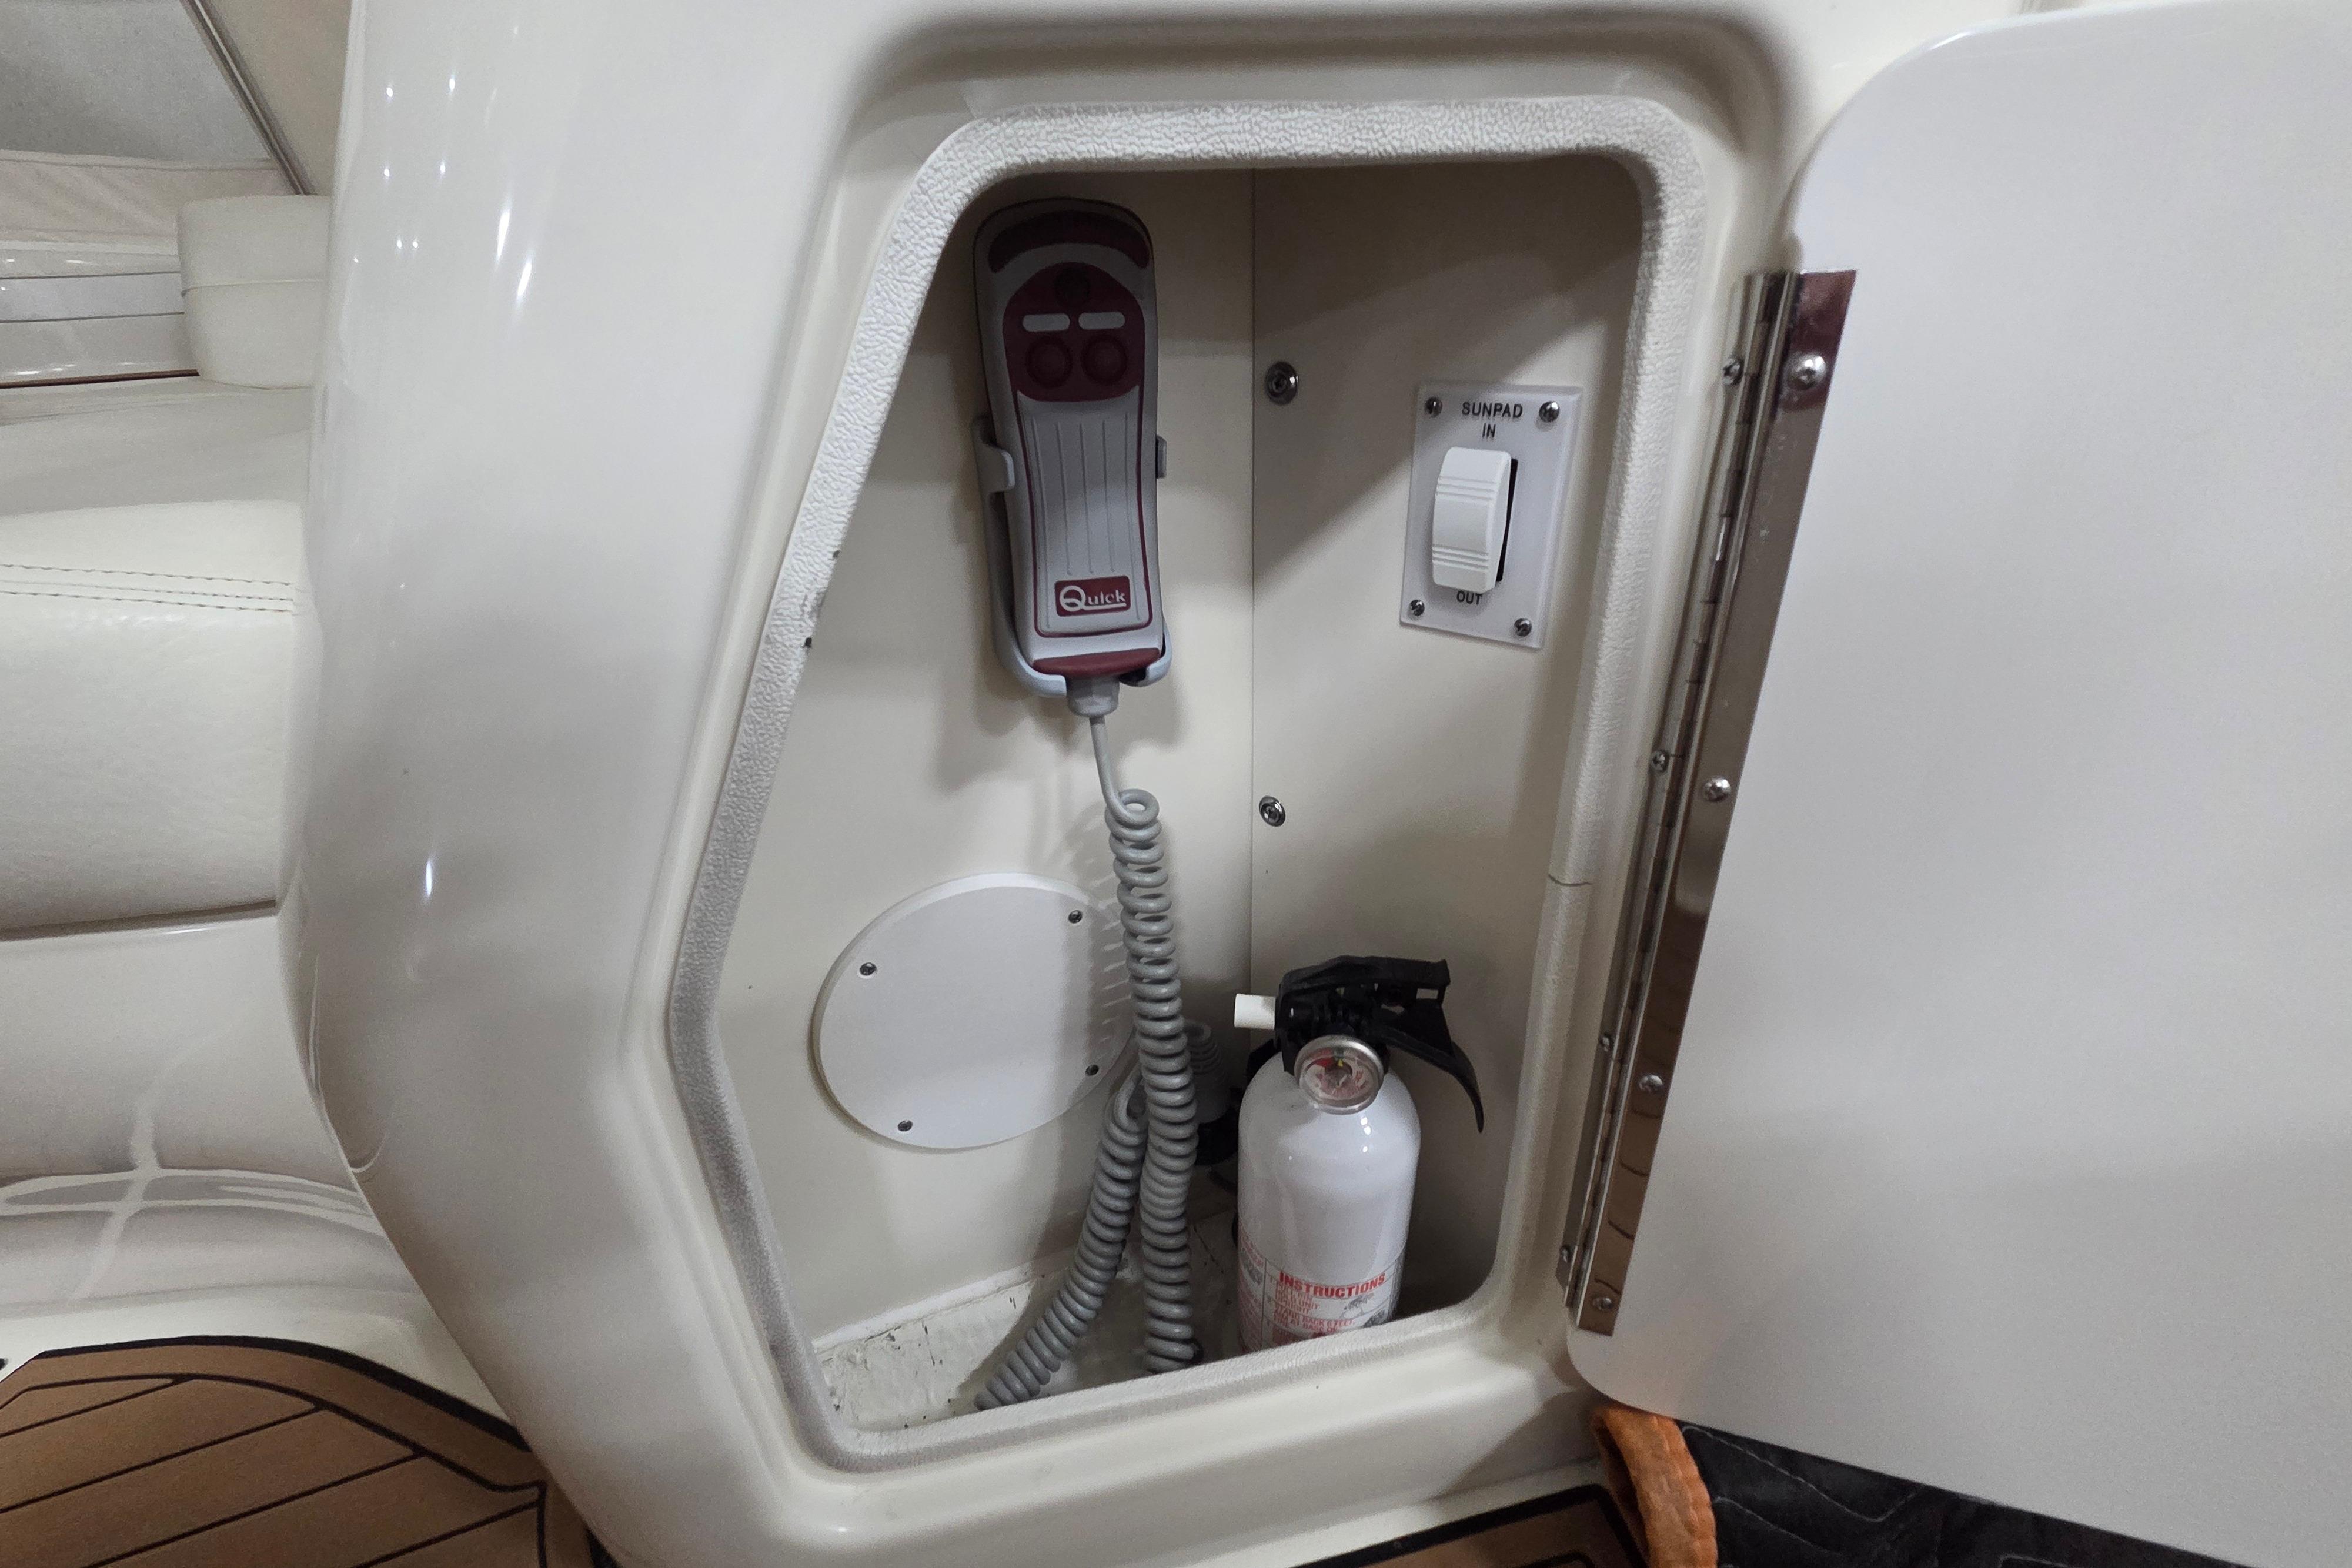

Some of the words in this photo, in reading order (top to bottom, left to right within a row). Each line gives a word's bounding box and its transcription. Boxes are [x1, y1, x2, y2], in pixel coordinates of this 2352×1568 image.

[1462, 402, 1523, 418] SUNPAD
[1482, 423, 1496, 438] IN
[1060, 585, 1127, 612] Quick
[1456, 590, 1482, 605] OUT
[1279, 1270, 1385, 1298] INSTRUCTIONS
